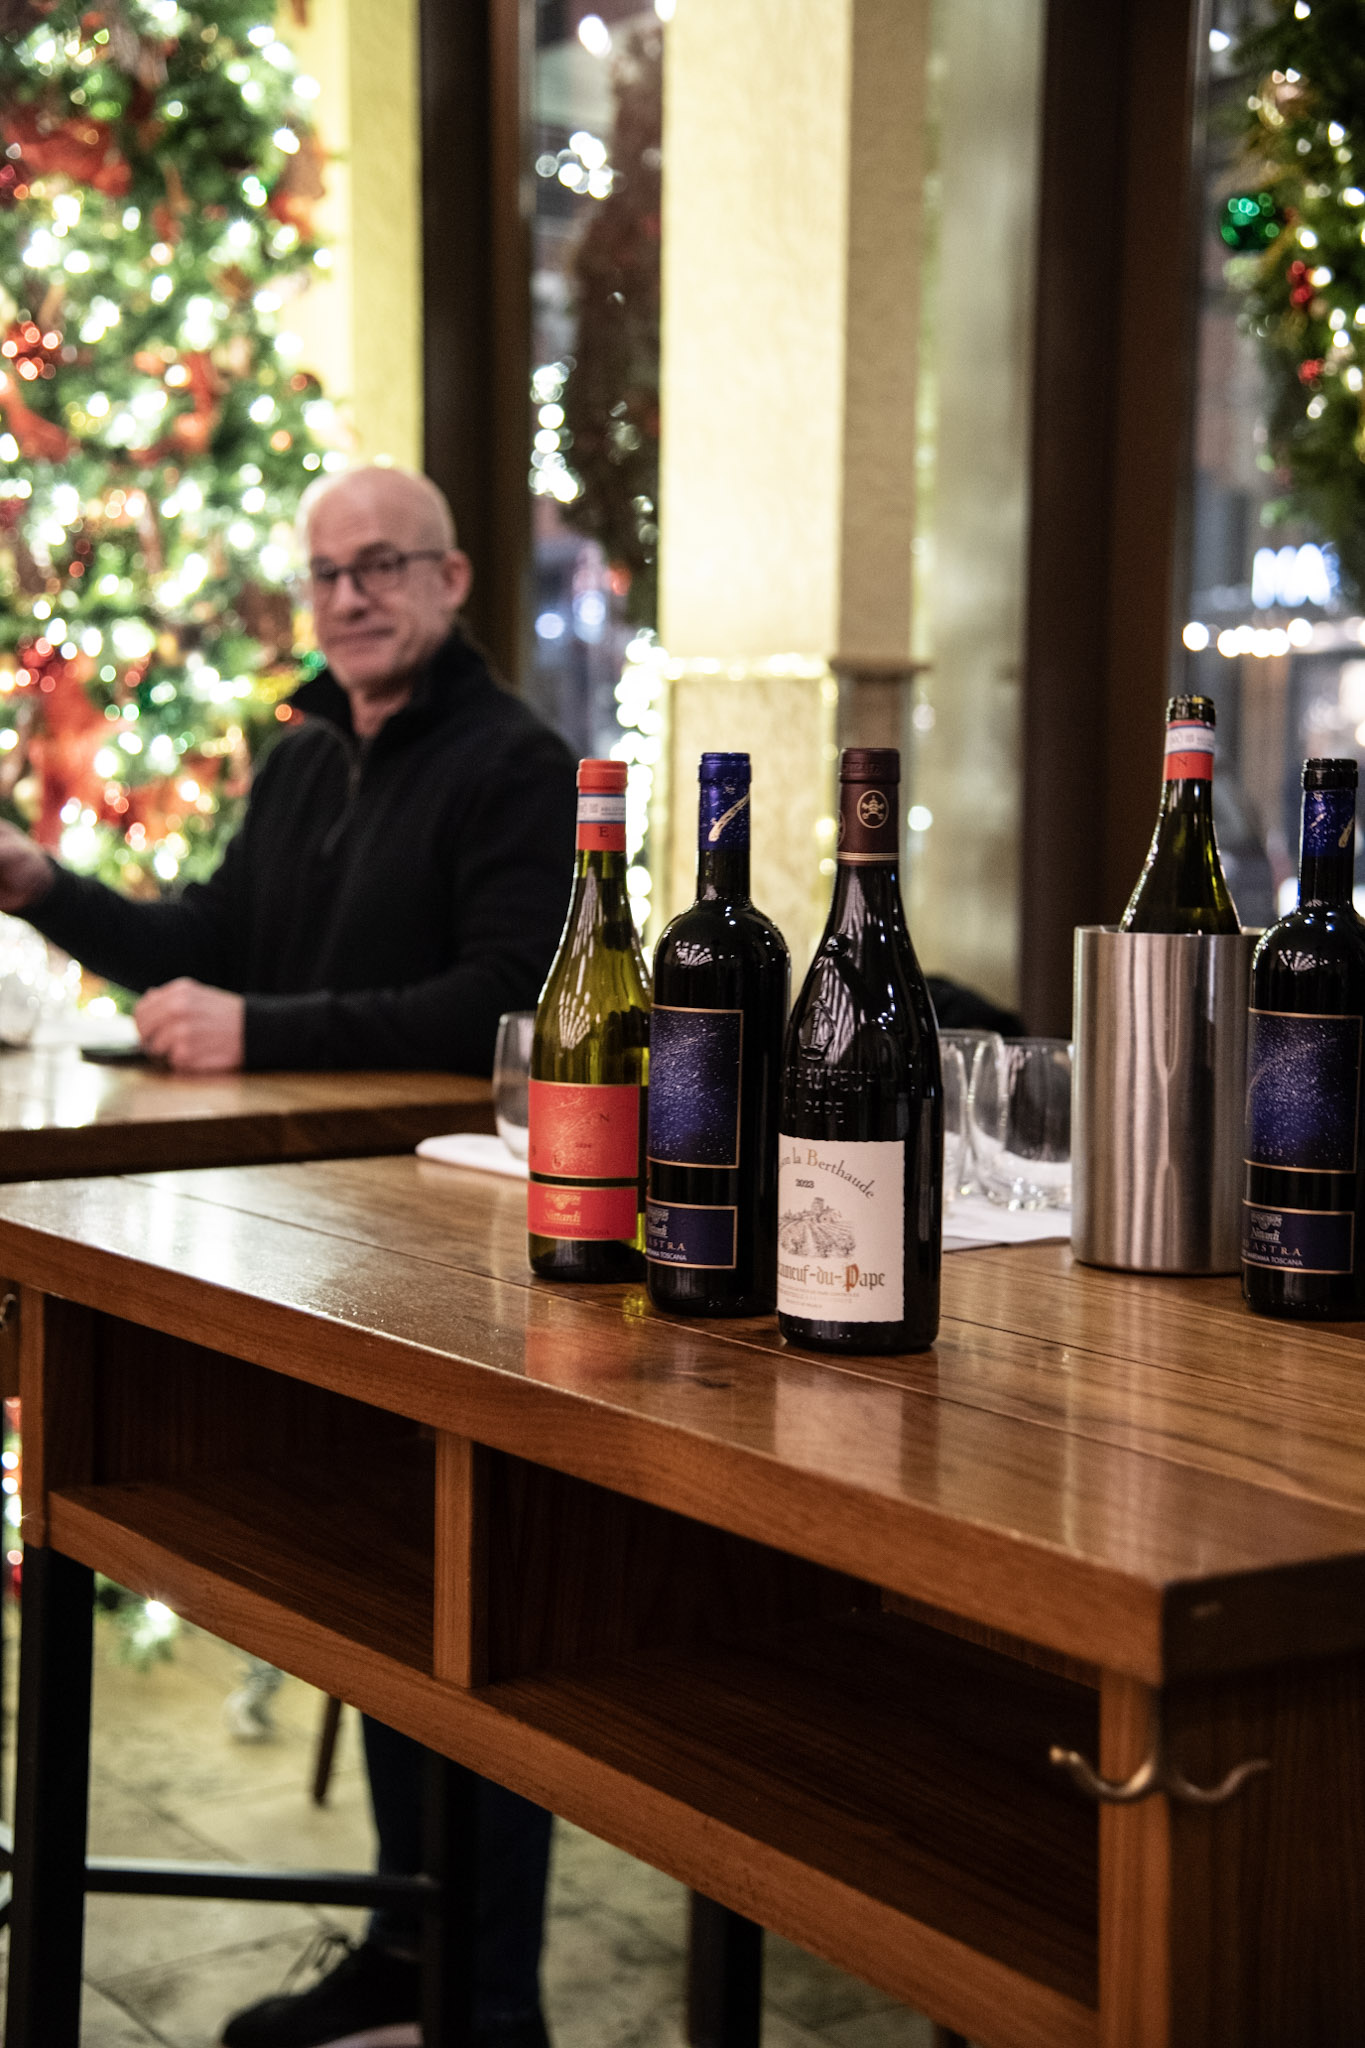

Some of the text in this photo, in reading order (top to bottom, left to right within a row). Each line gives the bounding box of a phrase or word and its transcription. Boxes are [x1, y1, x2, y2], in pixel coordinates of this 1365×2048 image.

[598, 825, 610, 838] E
[807, 1148, 876, 1199] Berthaude
[795, 1178, 816, 1189] 2023
[1253, 1241, 1303, 1257] ASTRA
[1270, 1255, 1304, 1267] TOSCANA
